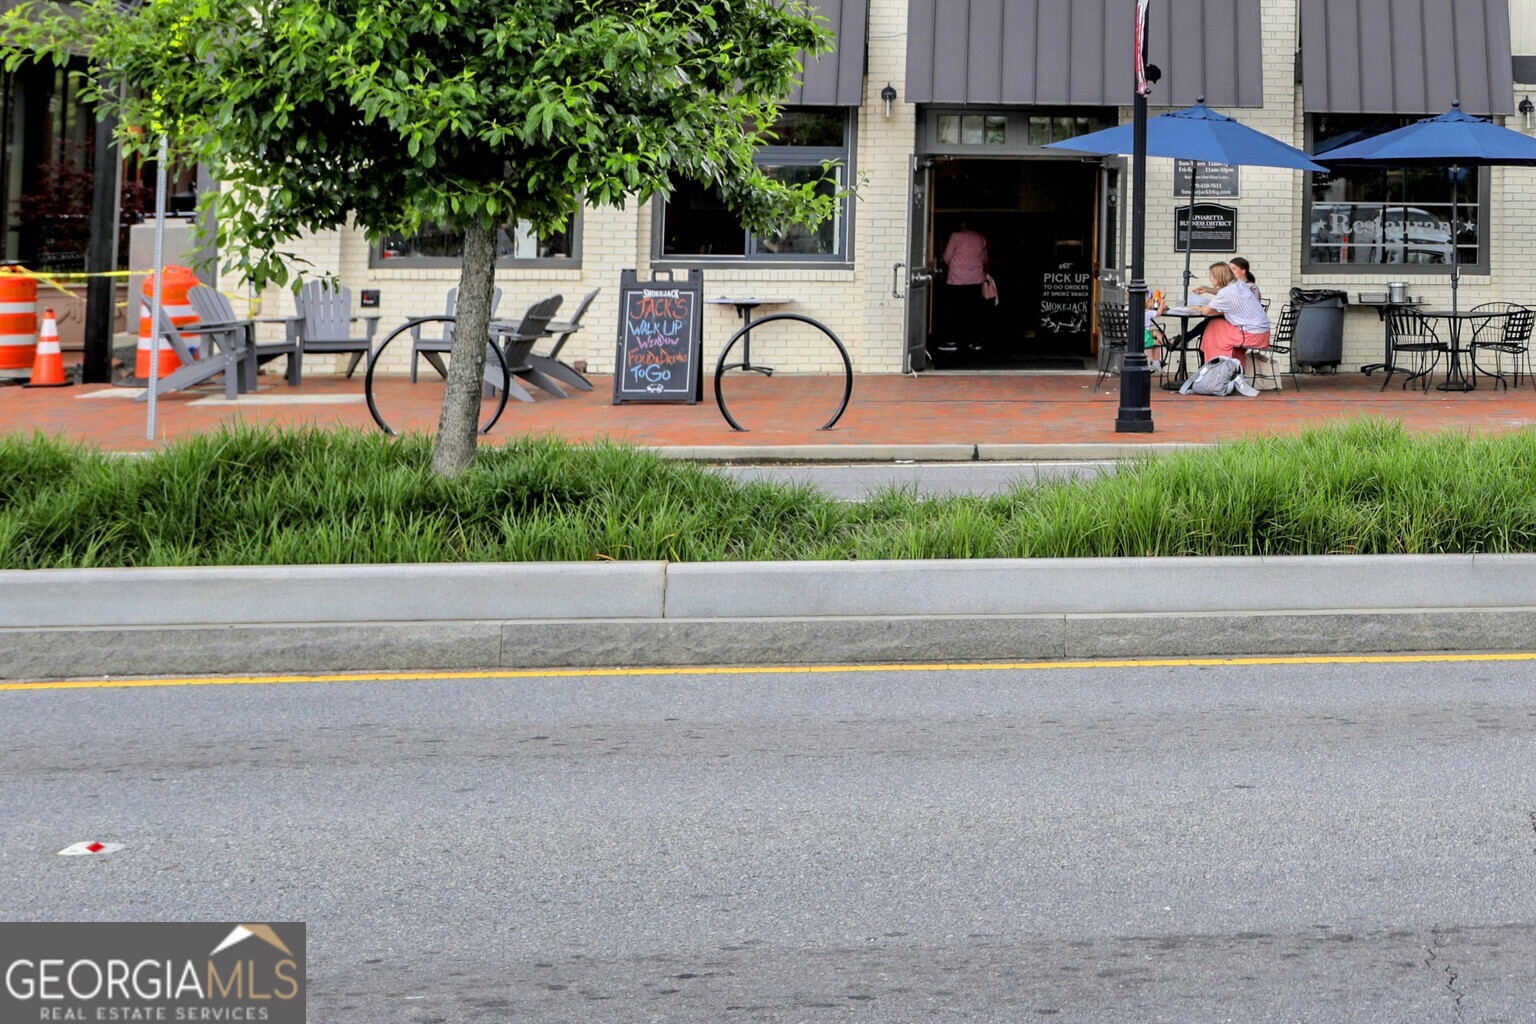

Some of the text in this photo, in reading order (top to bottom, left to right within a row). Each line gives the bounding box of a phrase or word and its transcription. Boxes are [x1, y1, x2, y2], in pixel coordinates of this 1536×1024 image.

[1043, 273, 1090, 283] PICK UP
[643, 289, 680, 299] SMOKEJACK
[630, 298, 689, 319] JACK'S
[1041, 300, 1088, 313] SMOKEJACK
[628, 320, 683, 336] WALK UP
